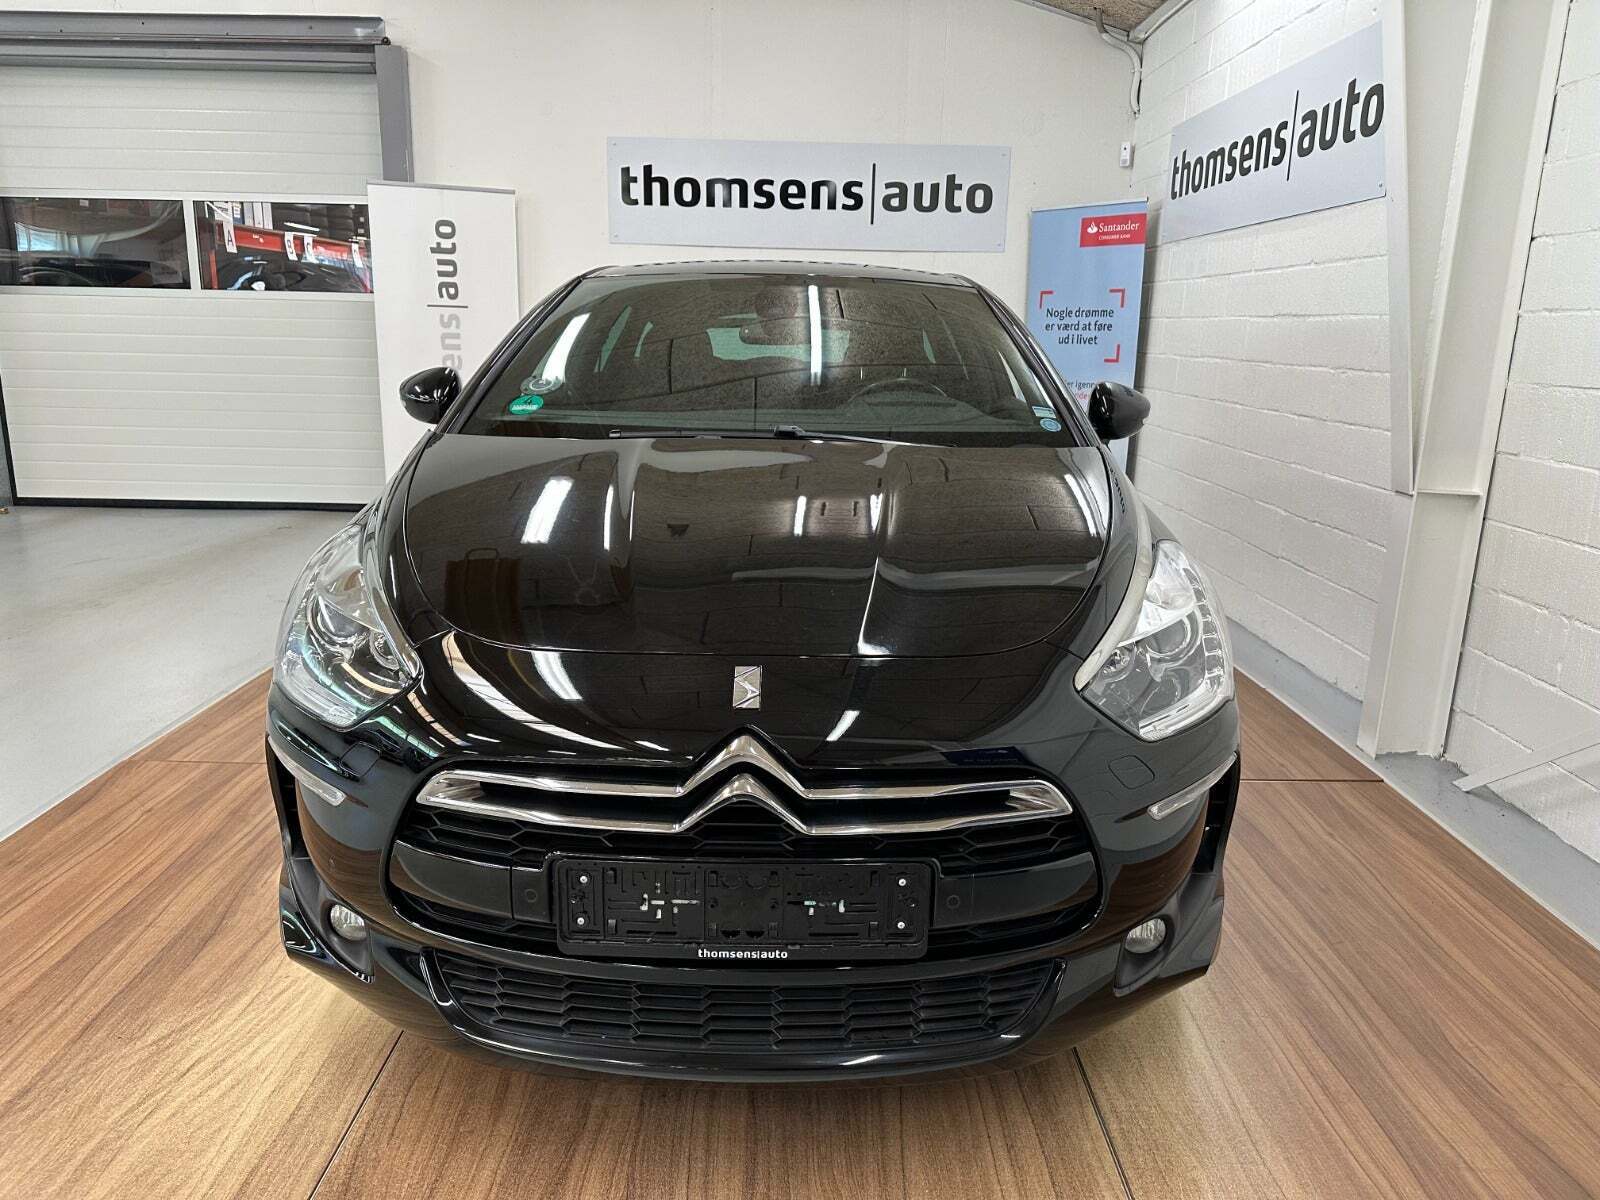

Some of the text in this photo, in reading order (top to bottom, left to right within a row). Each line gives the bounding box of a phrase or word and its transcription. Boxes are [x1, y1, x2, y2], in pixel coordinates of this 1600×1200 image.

[1098, 219, 1140, 233] Santander
[1046, 306, 1114, 320] Nogle drømme
[1045, 320, 1113, 331] er værd at føre
[1058, 333, 1070, 345] ud
[1076, 334, 1099, 345] livet
